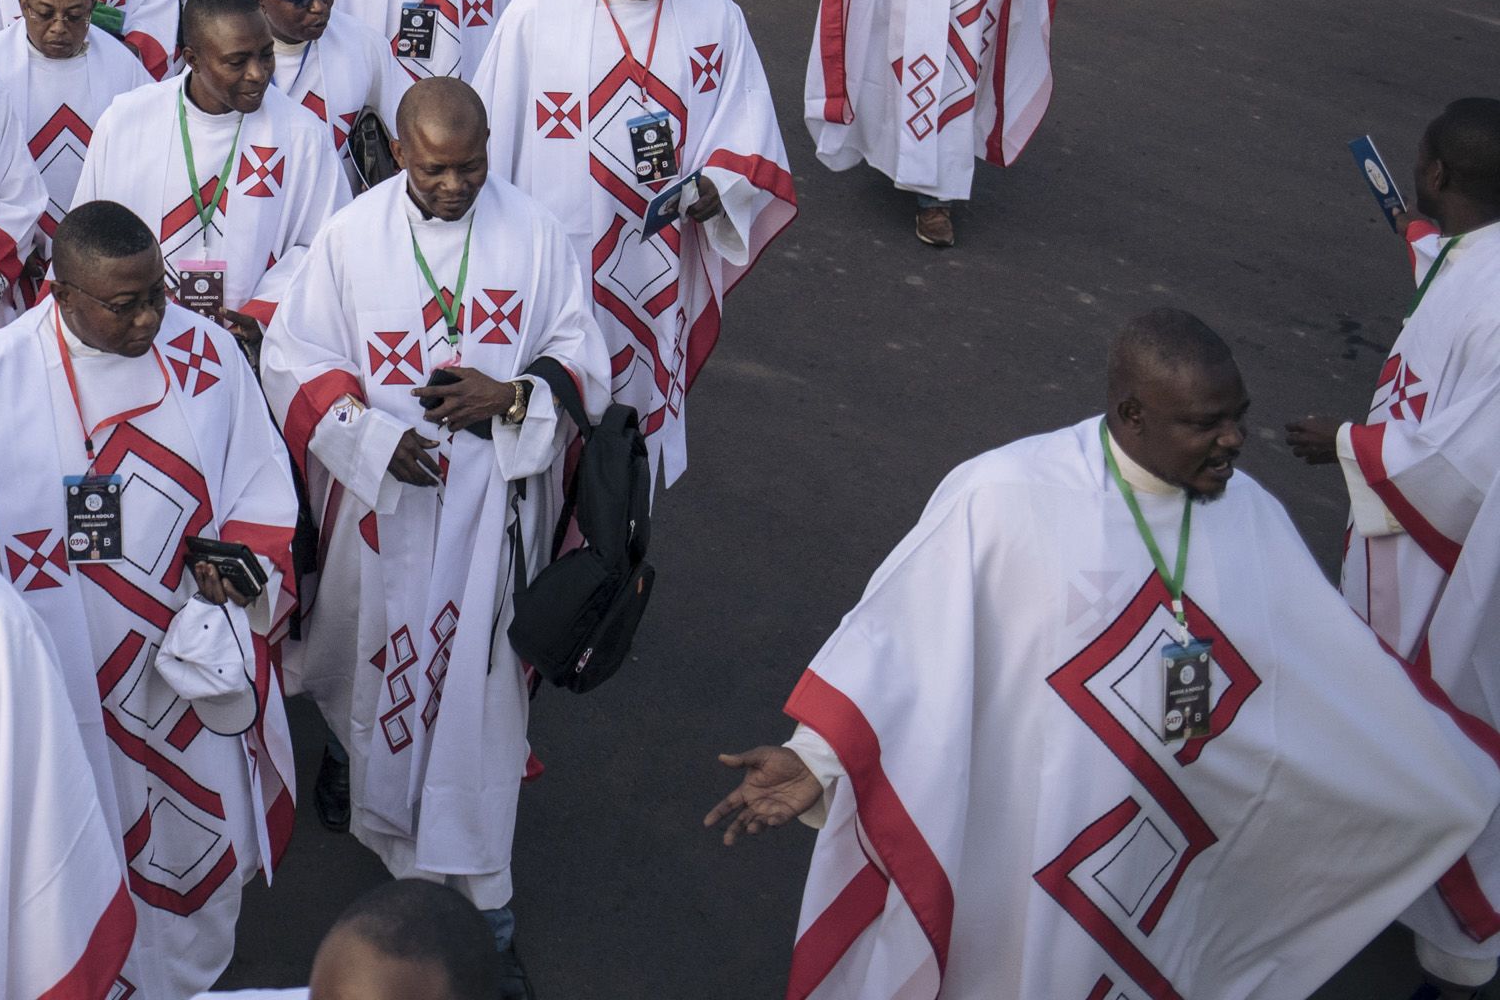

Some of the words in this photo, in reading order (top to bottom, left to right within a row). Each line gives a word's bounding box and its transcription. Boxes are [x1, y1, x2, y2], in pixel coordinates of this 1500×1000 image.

[661, 160, 669, 168] B
[70, 538, 89, 546] 0394
[103, 537, 111, 547] B
[1195, 712, 1202, 722] B
